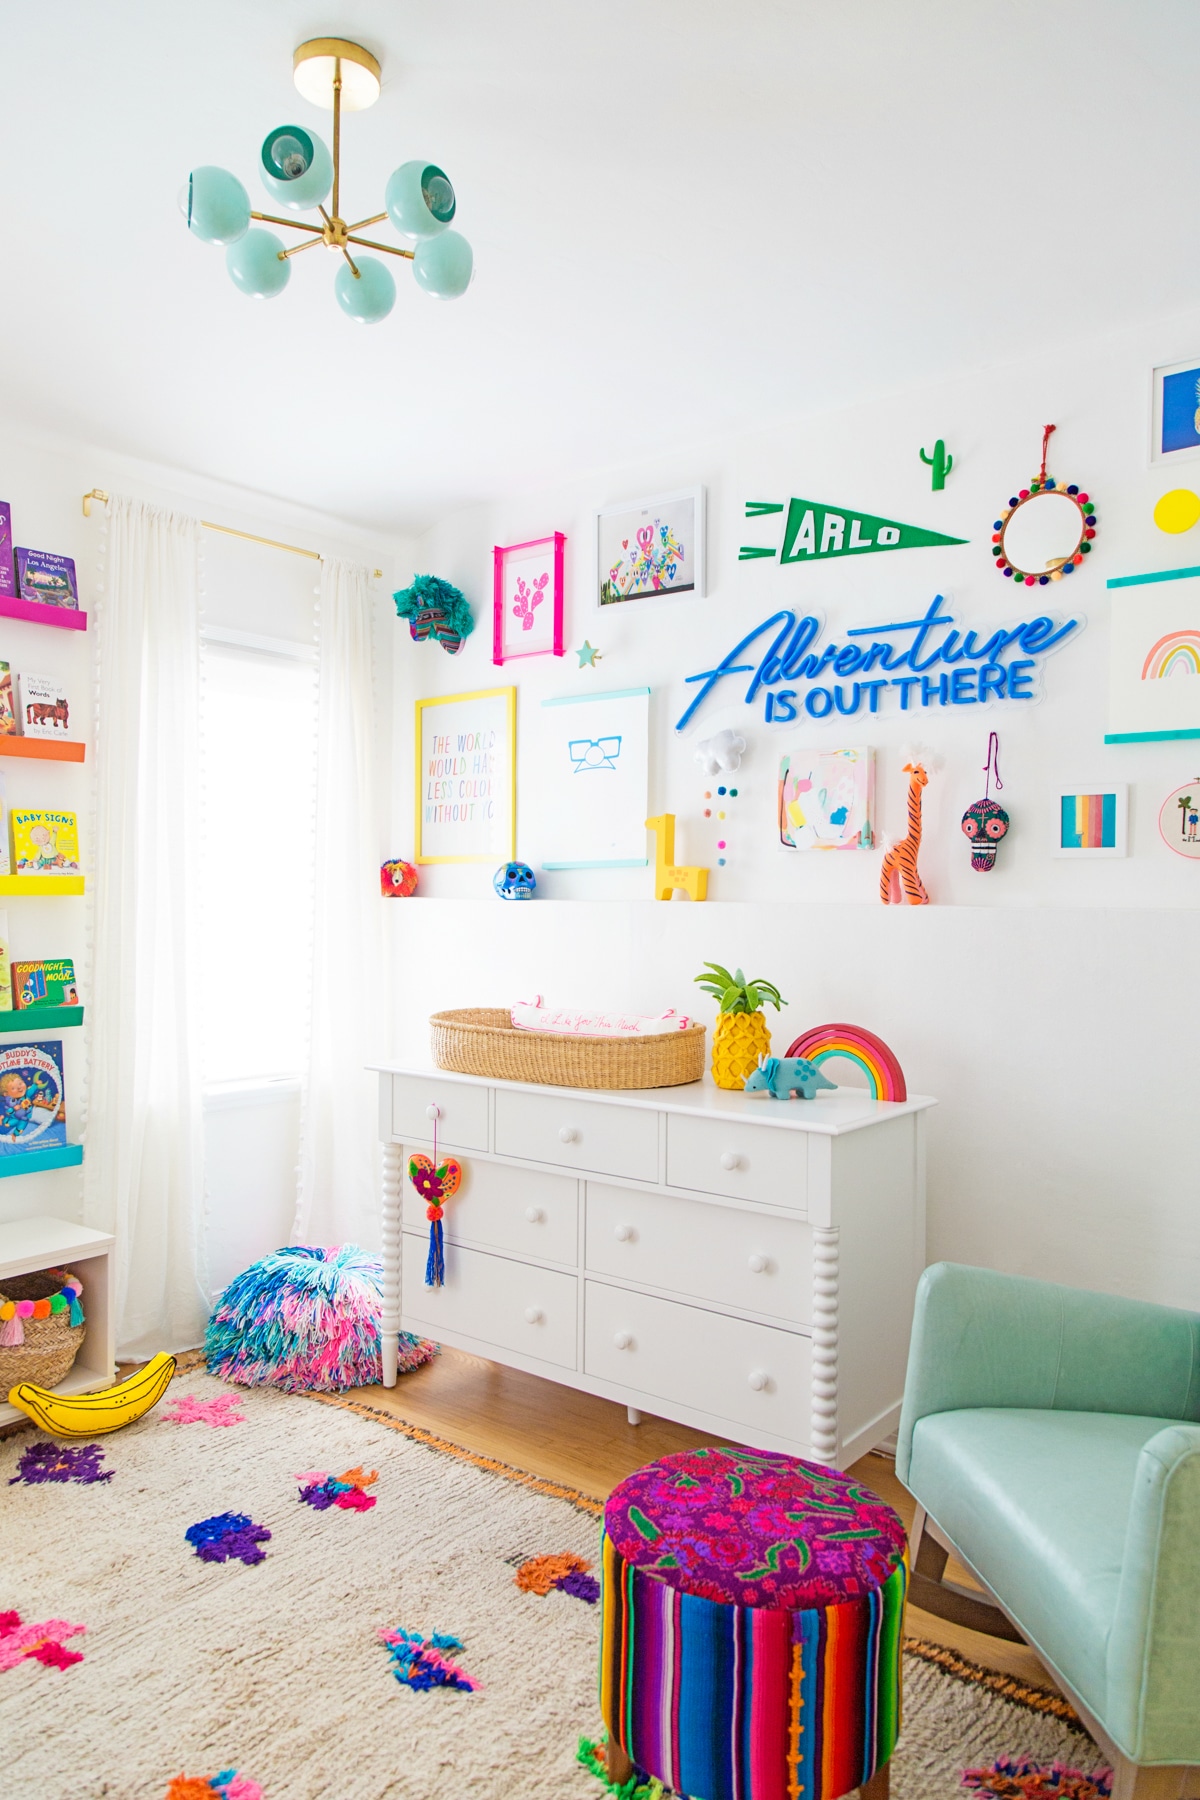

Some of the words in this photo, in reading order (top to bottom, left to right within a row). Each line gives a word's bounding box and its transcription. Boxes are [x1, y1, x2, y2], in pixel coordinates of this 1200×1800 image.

[789, 509, 900, 558] ARLO
[28, 550, 45, 560] Good
[46, 553, 64, 564] Night
[27, 558, 39, 567] Los
[40, 562, 67, 572] Angeles
[675, 594, 1078, 731] Adventure
[28, 689, 50, 698] Words
[765, 690, 798, 723] IS
[804, 679, 888, 719] OUT
[891, 660, 1036, 711] THERE
[432, 735, 451, 754] THE
[457, 731, 496, 753] WORLD
[429, 757, 467, 778] WOULD
[427, 780, 453, 800] LESS
[16, 813, 41, 825] BABY
[45, 813, 74, 826] SIGNS
[425, 803, 475, 823] WITHOUT
[17, 962, 64, 973] GOODNIGHT
[46, 972, 72, 981] MOON
[5, 1049, 37, 1060] BUDDY'S
[23, 1058, 55, 1071] BATTERY
